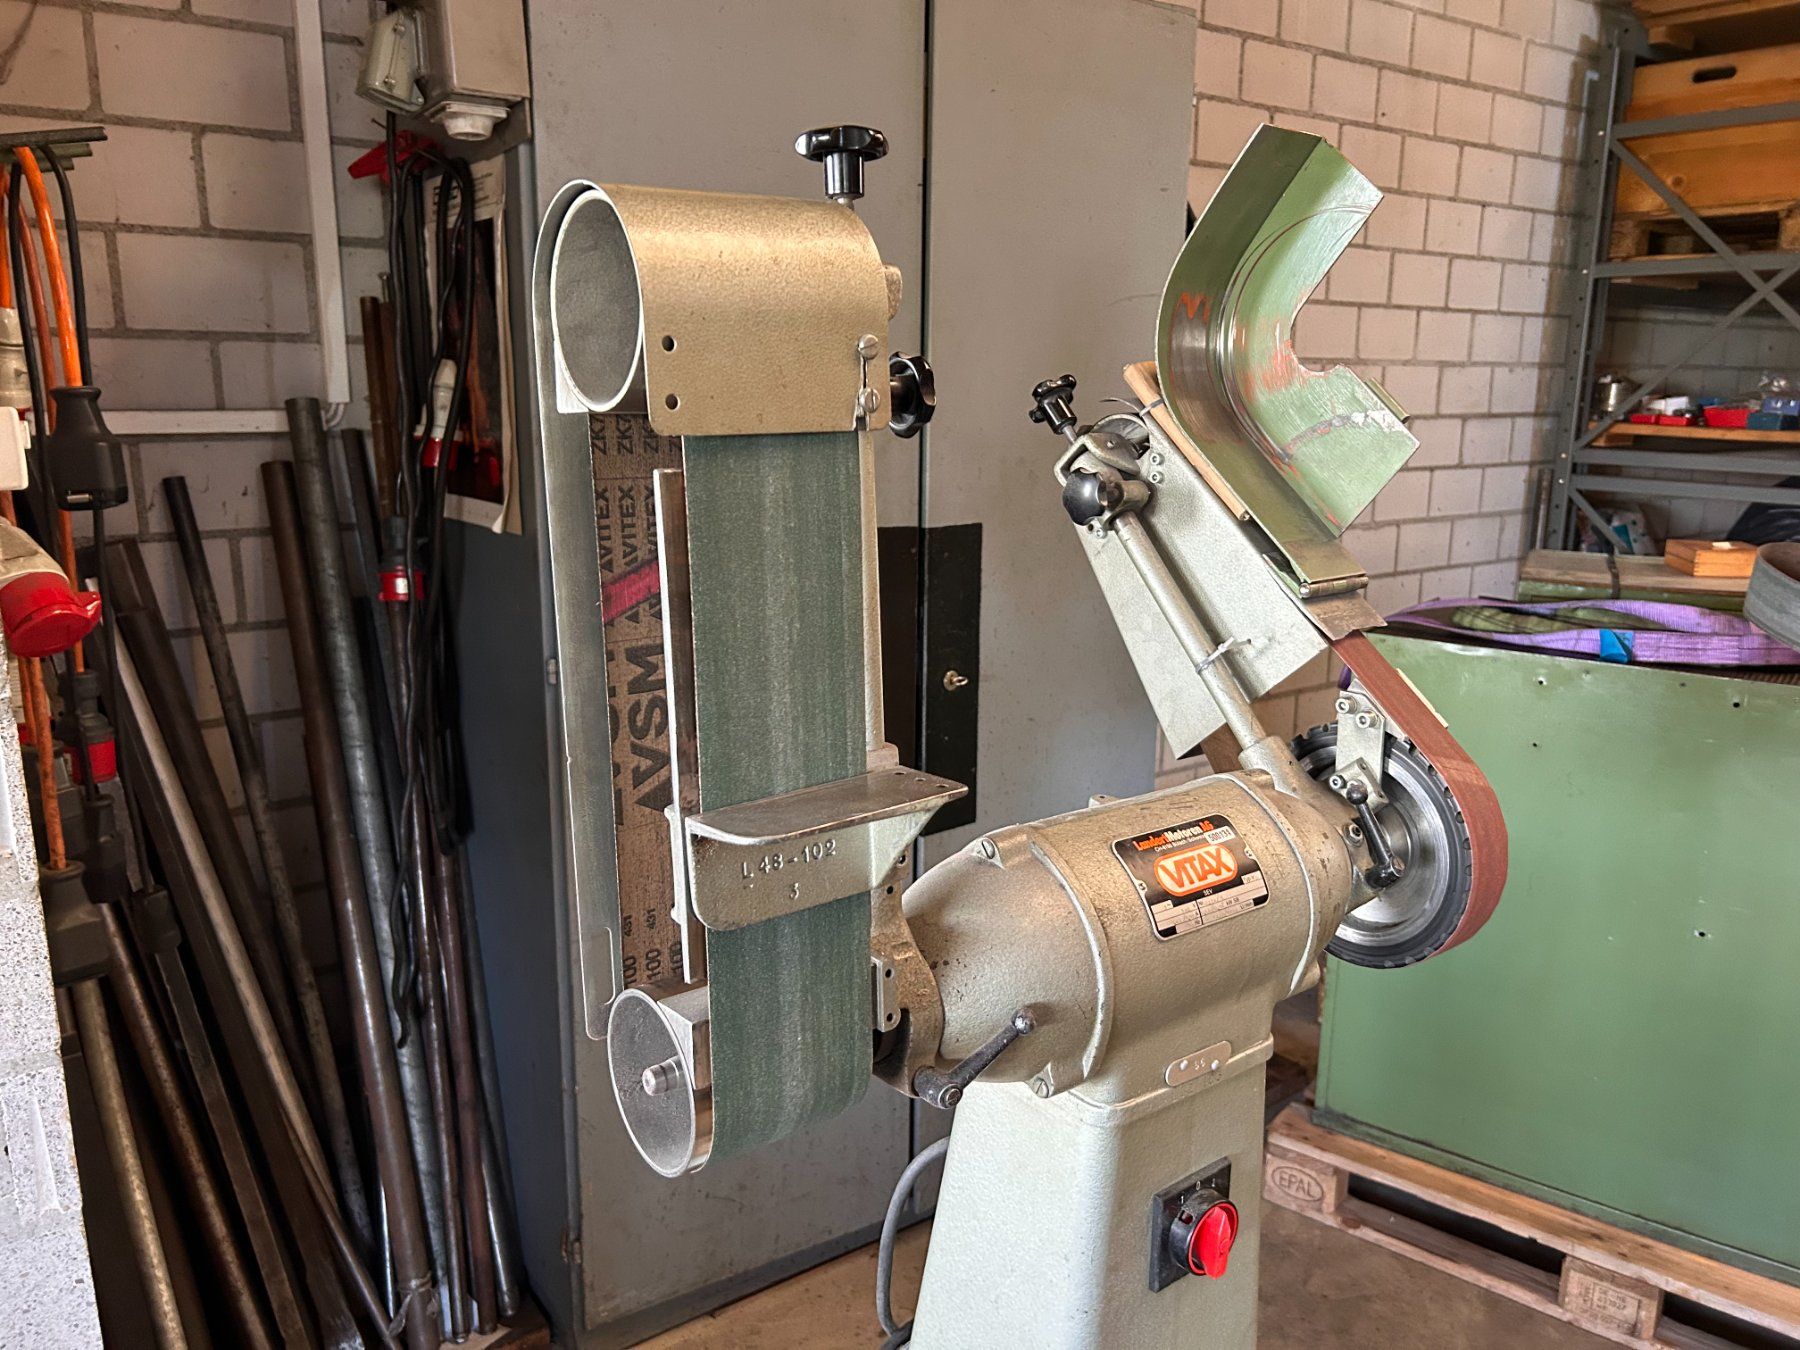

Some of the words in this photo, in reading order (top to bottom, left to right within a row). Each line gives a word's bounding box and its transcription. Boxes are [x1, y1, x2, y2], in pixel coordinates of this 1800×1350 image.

[1158, 848, 1233, 889] VITAX
[645, 949, 662, 981] 100
[1279, 1170, 1316, 1199] EPAL
